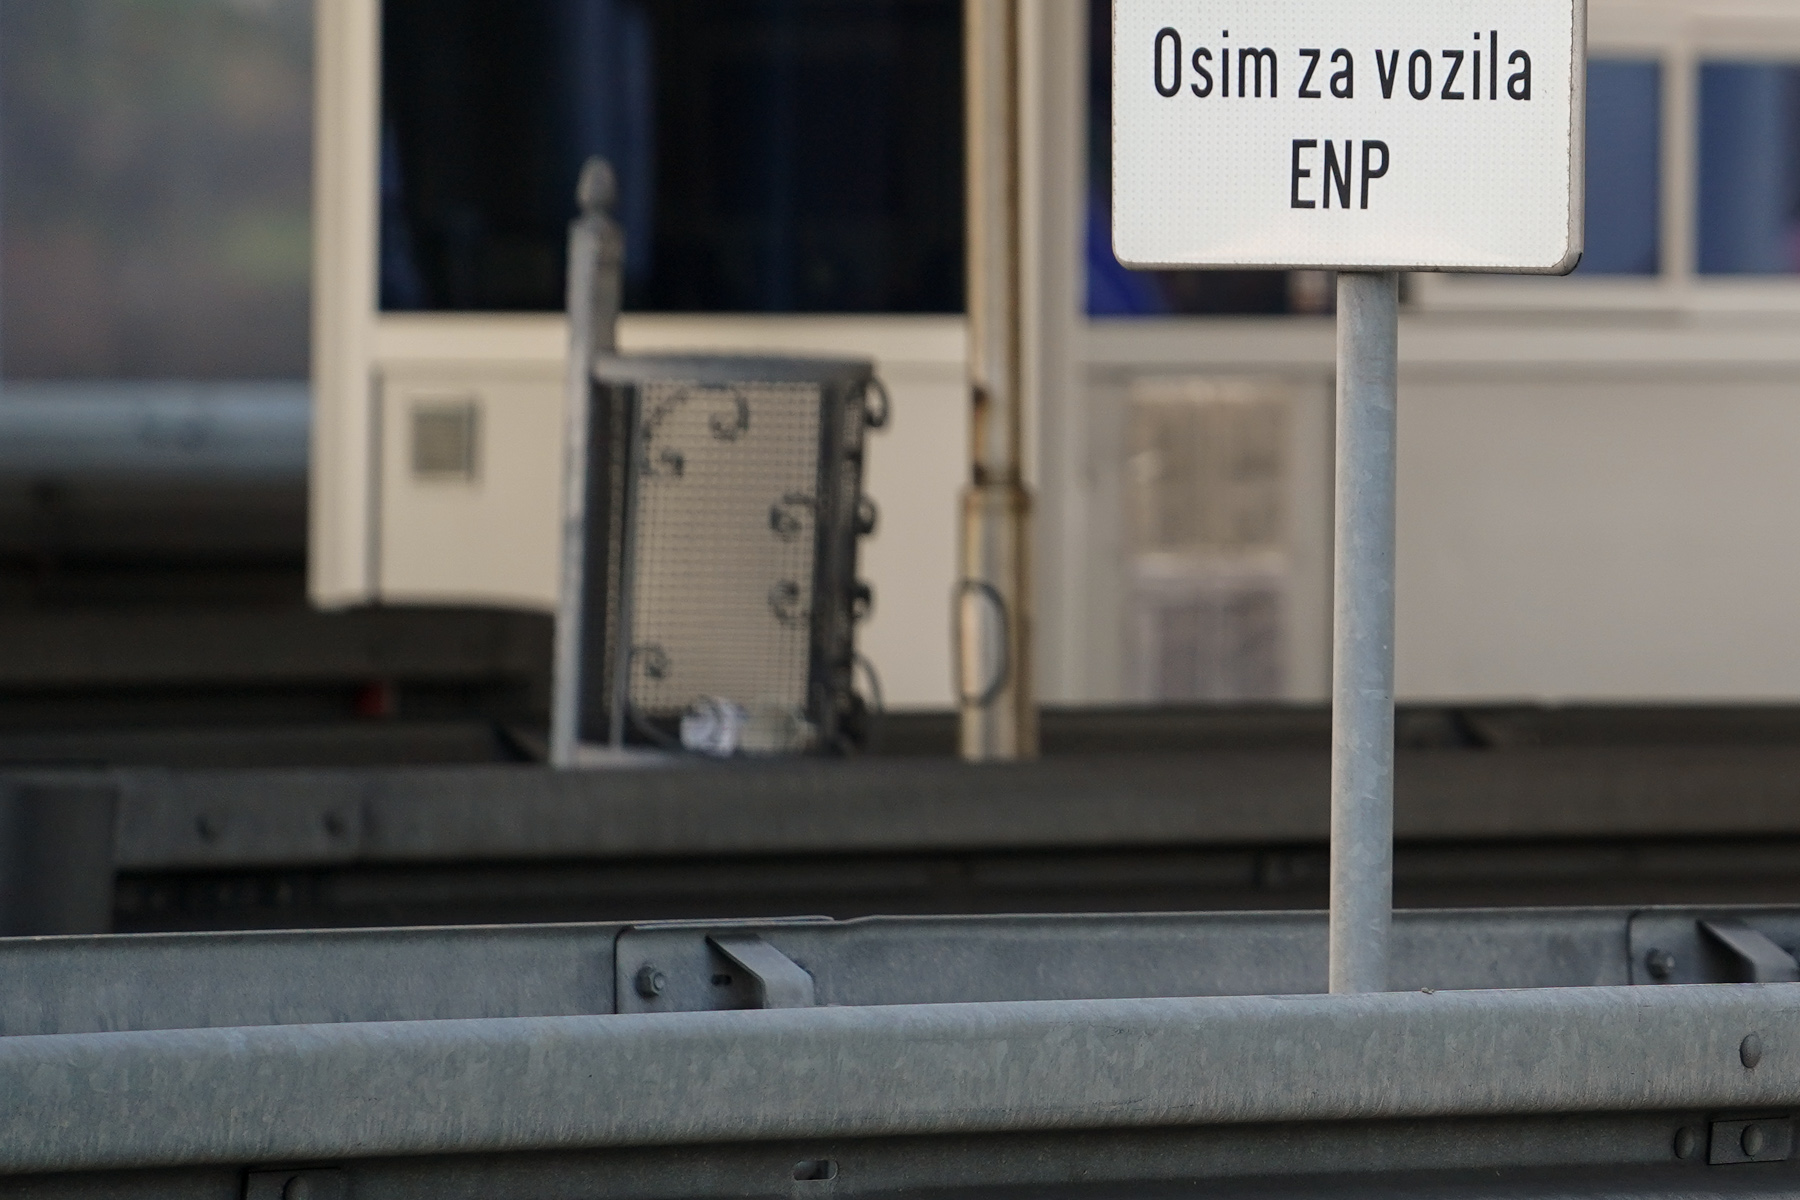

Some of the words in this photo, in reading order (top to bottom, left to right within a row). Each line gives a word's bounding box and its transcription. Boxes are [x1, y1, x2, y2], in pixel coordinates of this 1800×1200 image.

[1154, 27, 1278, 99] Osim
[1298, 48, 1354, 99] za
[1375, 30, 1532, 101] vozila
[1290, 139, 1390, 210] ENP
